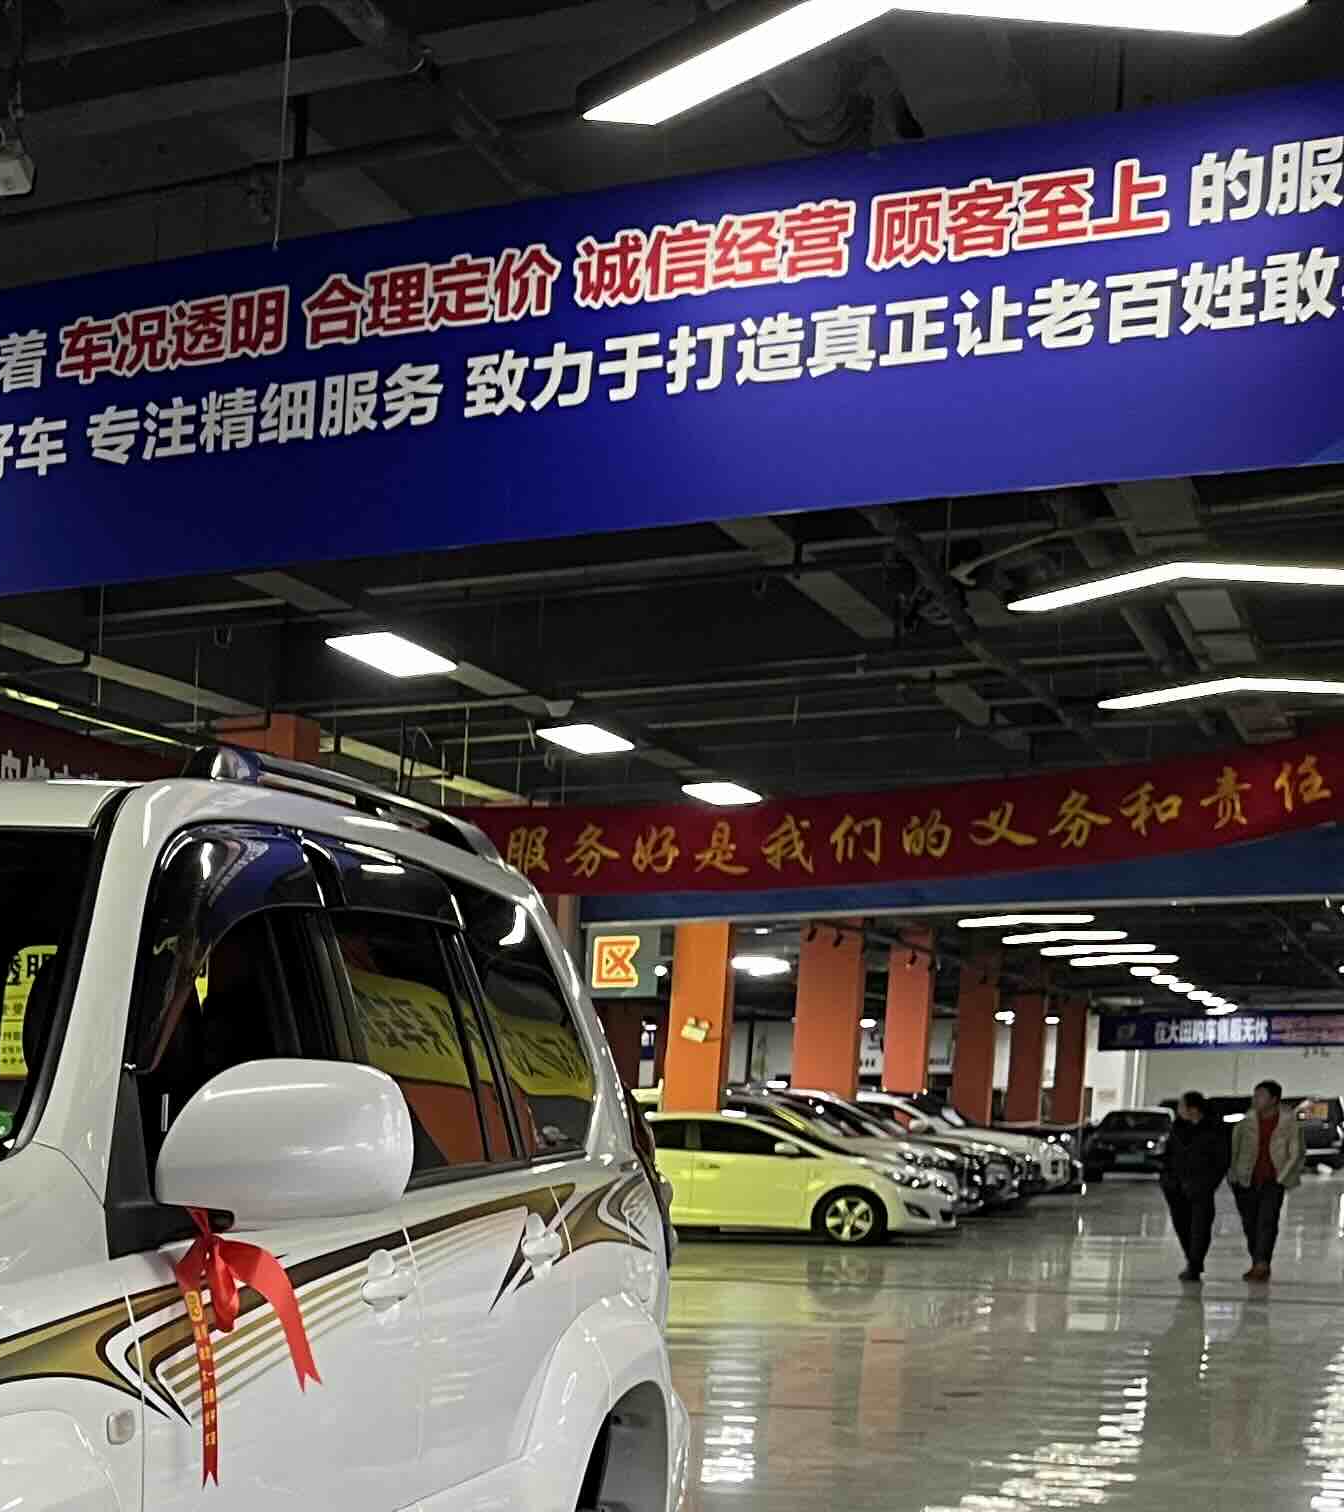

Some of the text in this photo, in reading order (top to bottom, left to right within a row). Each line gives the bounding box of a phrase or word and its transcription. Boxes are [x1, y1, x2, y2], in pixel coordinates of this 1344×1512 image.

[56, 285, 291, 386] 车况透明
[302, 243, 563, 350] 合理定价
[574, 199, 856, 310] 诚信经营
[864, 157, 1170, 273] 顾客至上
[1188, 135, 1344, 227] 的服
[86, 362, 445, 466] 专注精细服务
[463, 247, 1344, 418] 致力于打造真正让老百姓敢
[506, 755, 1333, 879] 服务好是我们的义务和责任
